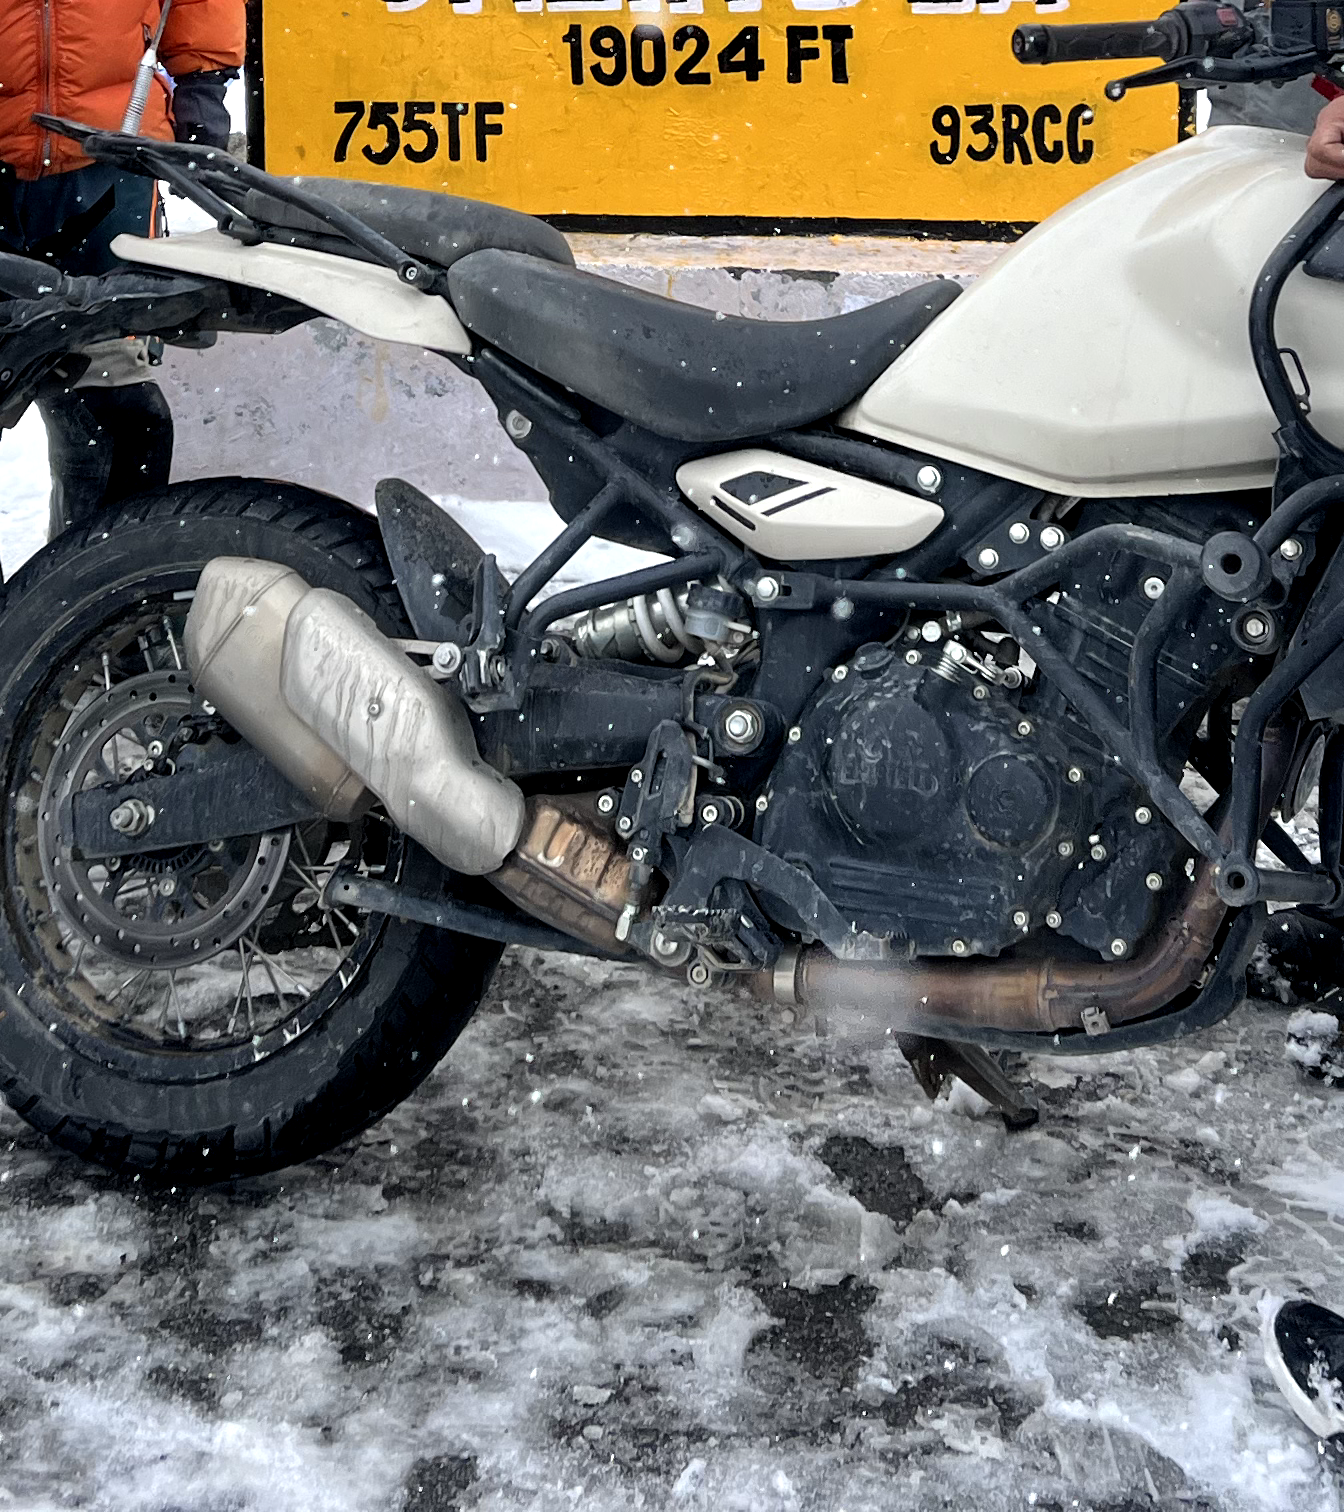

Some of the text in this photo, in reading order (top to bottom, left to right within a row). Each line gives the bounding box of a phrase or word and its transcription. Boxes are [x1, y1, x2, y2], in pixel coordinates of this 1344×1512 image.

[563, 24, 853, 86] 19024 FT
[334, 101, 504, 165] 755TF
